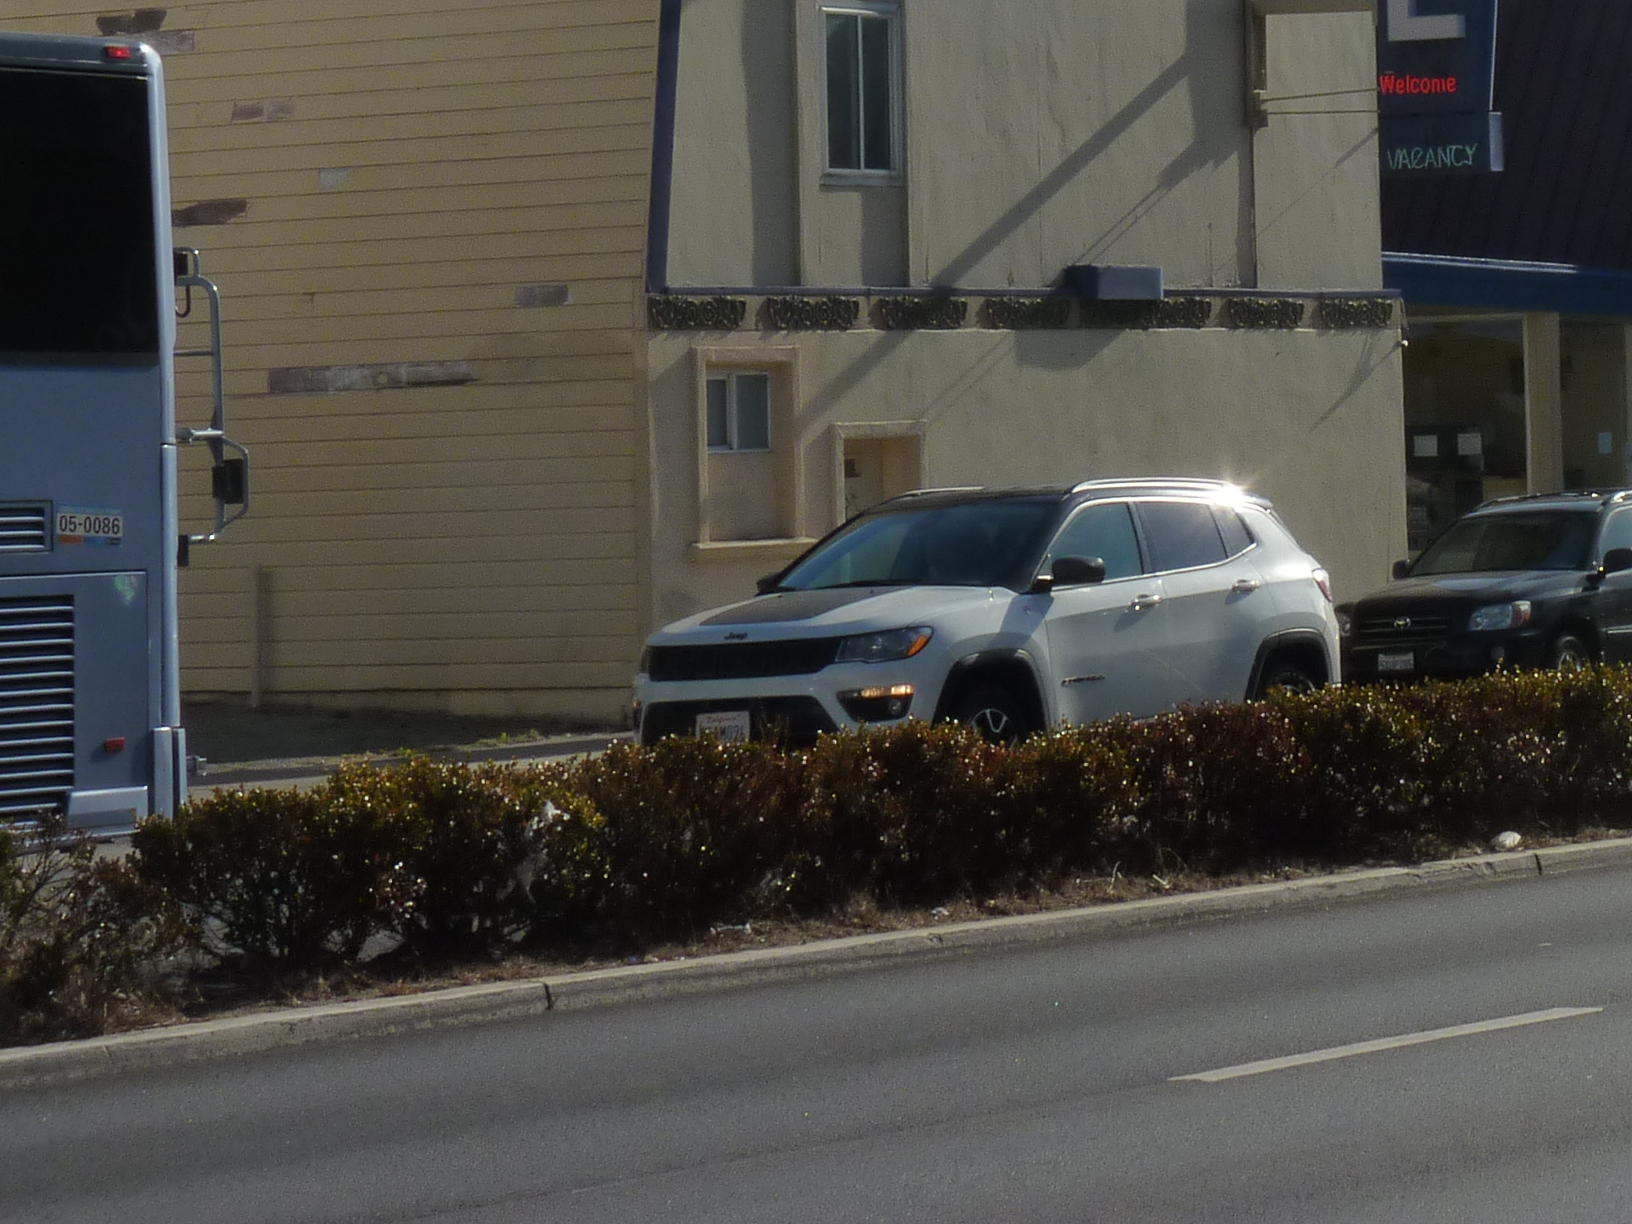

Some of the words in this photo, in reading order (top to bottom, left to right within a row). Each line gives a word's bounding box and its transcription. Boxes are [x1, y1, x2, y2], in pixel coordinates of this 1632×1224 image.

[1379, 73, 1458, 94] Welcome
[1387, 143, 1478, 170] VACANCY
[59, 514, 120, 535] 05-0086
